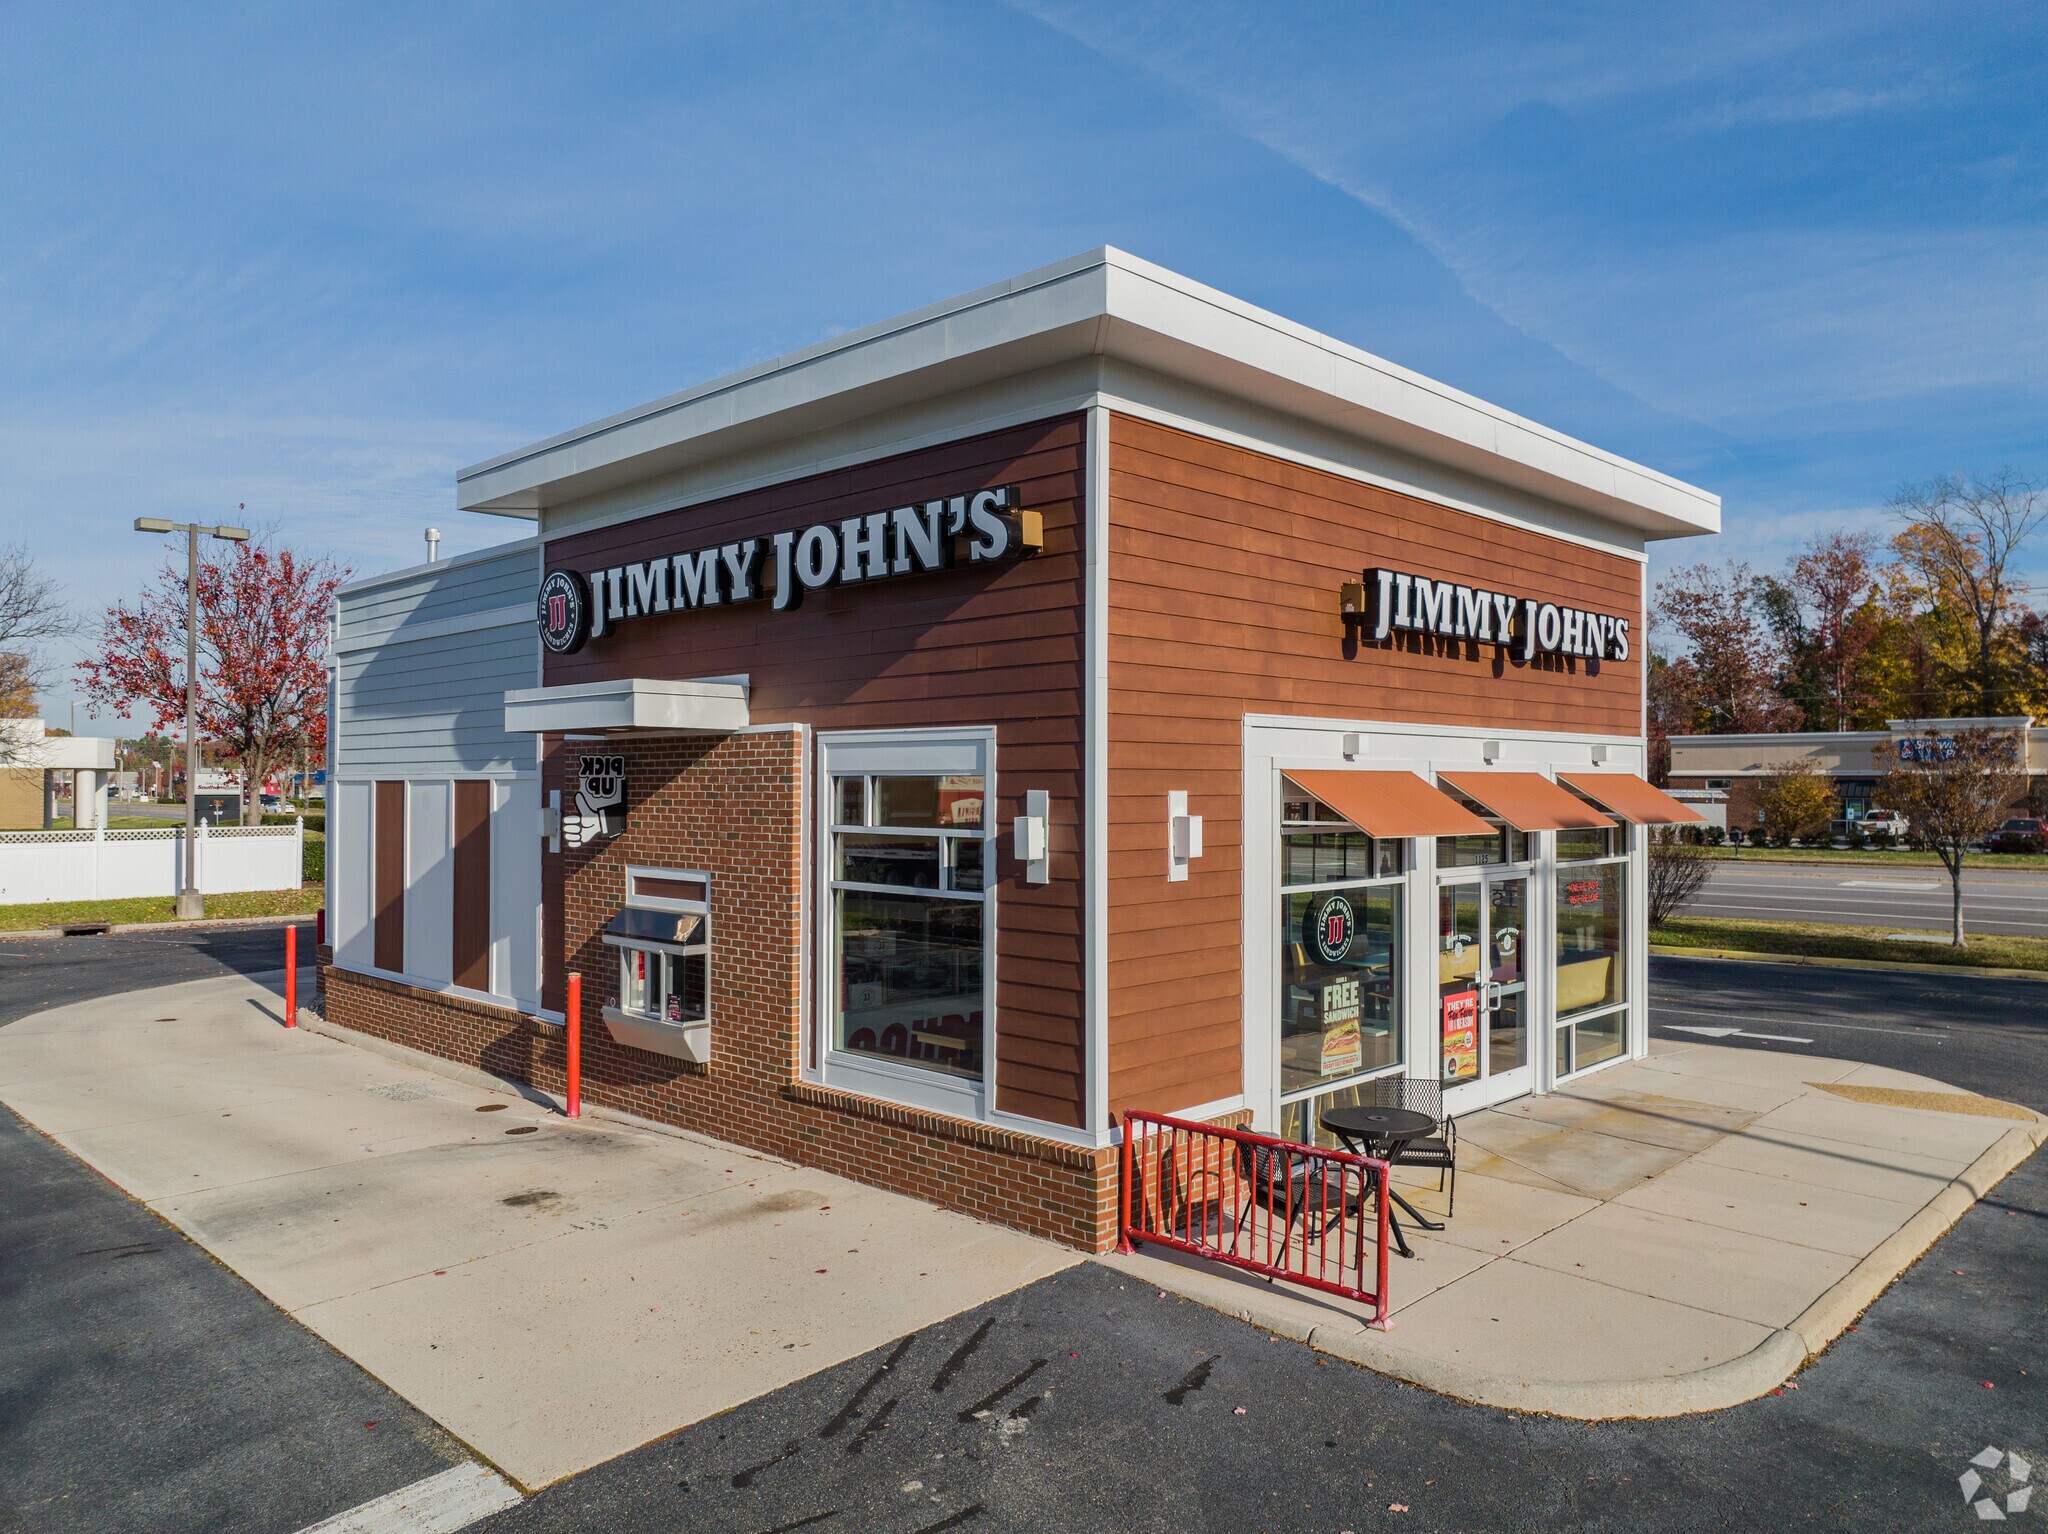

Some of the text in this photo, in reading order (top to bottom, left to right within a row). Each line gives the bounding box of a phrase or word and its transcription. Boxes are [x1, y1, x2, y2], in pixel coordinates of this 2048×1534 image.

[591, 487, 1013, 638] JIMMY JOHN'S
[541, 577, 575, 615] JIMMY JOHN'S
[548, 594, 566, 632] JJ
[1375, 569, 1629, 661] JIMMY JOHN'S
[544, 622, 574, 646] SANDWICHES
[1475, 854, 1488, 864] 1125
[1320, 901, 1351, 931] JIMMY JOHN'S
[1327, 915, 1344, 945] JJ
[1321, 937, 1350, 957] SANDWICHES
[1323, 981, 1359, 1011] FREE
[1447, 997, 1474, 1011] THEY'RE
[1323, 1006, 1359, 1024] SANDWICH
[1457, 1015, 1474, 1030] REASON
